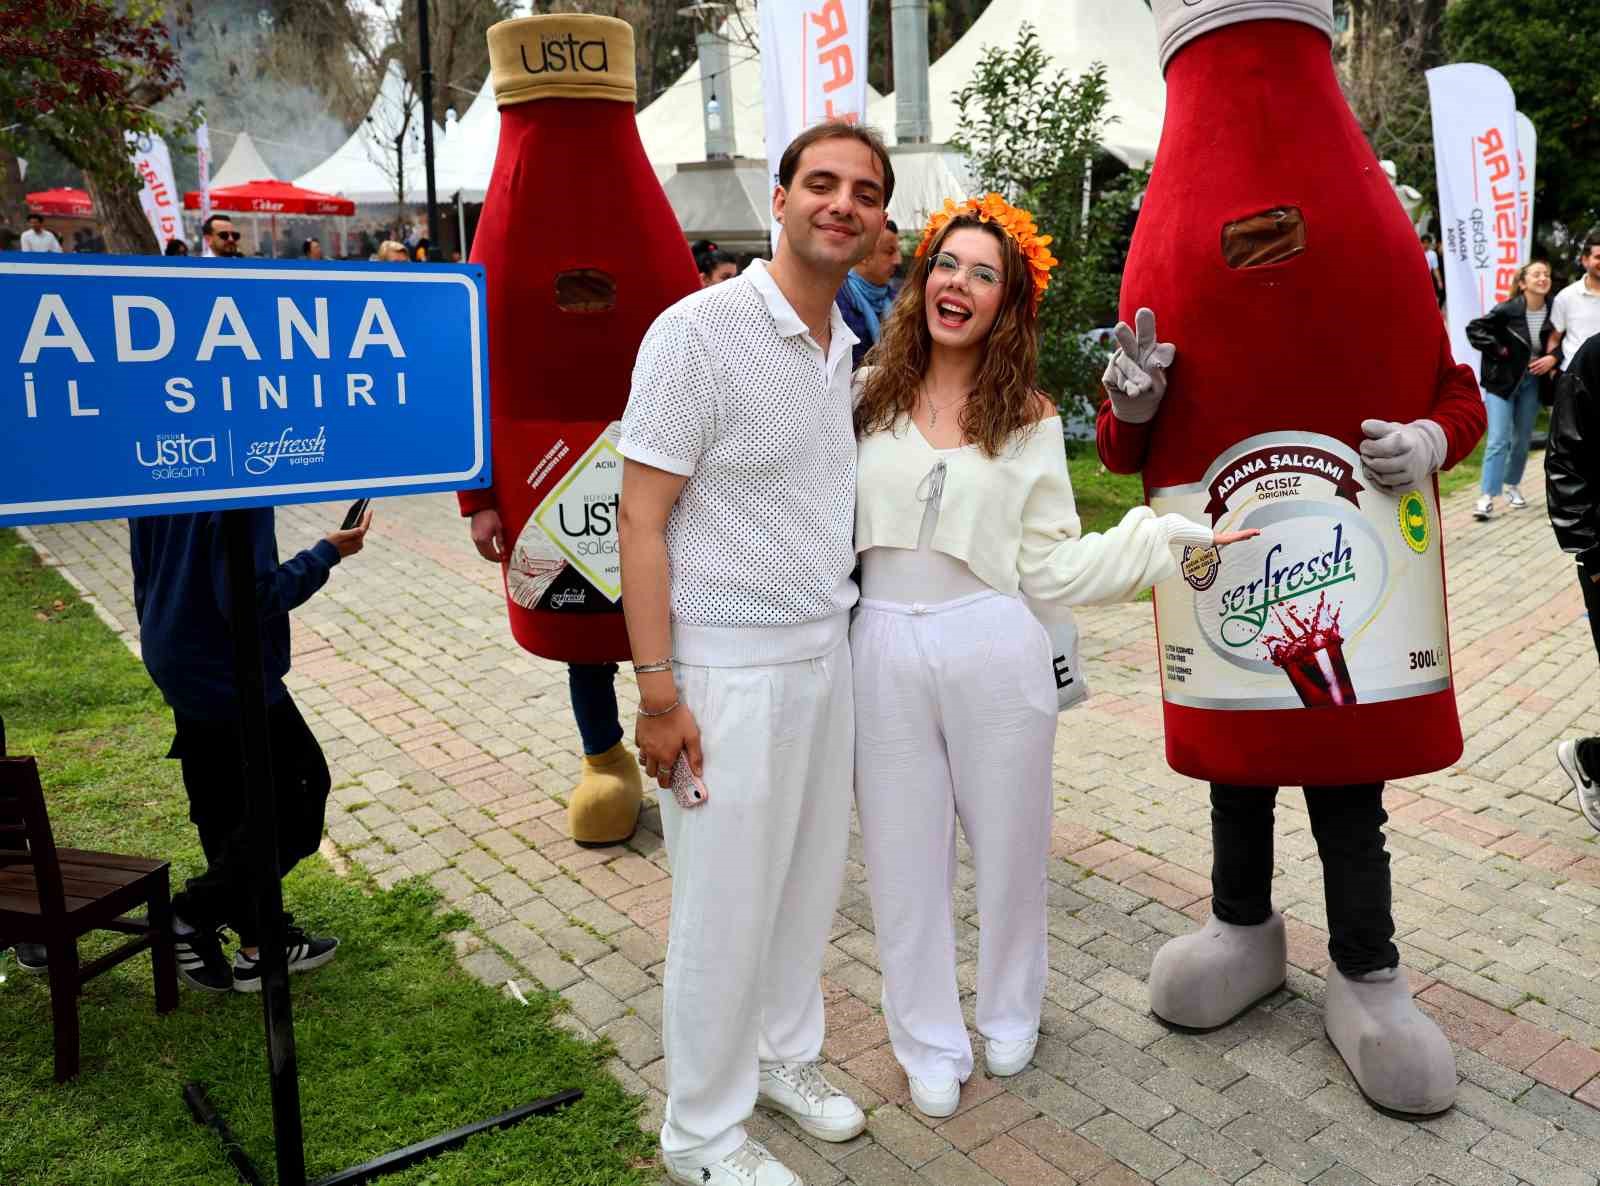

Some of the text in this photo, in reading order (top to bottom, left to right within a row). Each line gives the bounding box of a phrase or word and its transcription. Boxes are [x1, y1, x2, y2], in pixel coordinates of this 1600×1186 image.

[520, 33, 608, 74] usta
[18, 293, 408, 364] ADANA
[23, 371, 407, 418] İL SINIRI
[135, 432, 216, 467] usta
[244, 425, 327, 476] serfressh
[1217, 453, 1345, 499] ADANA ŞALGAMI
[1255, 475, 1303, 493] ACISIZ
[558, 493, 619, 537] ust
[1218, 521, 1356, 648] serfressh
[1409, 649, 1437, 670] 300L
